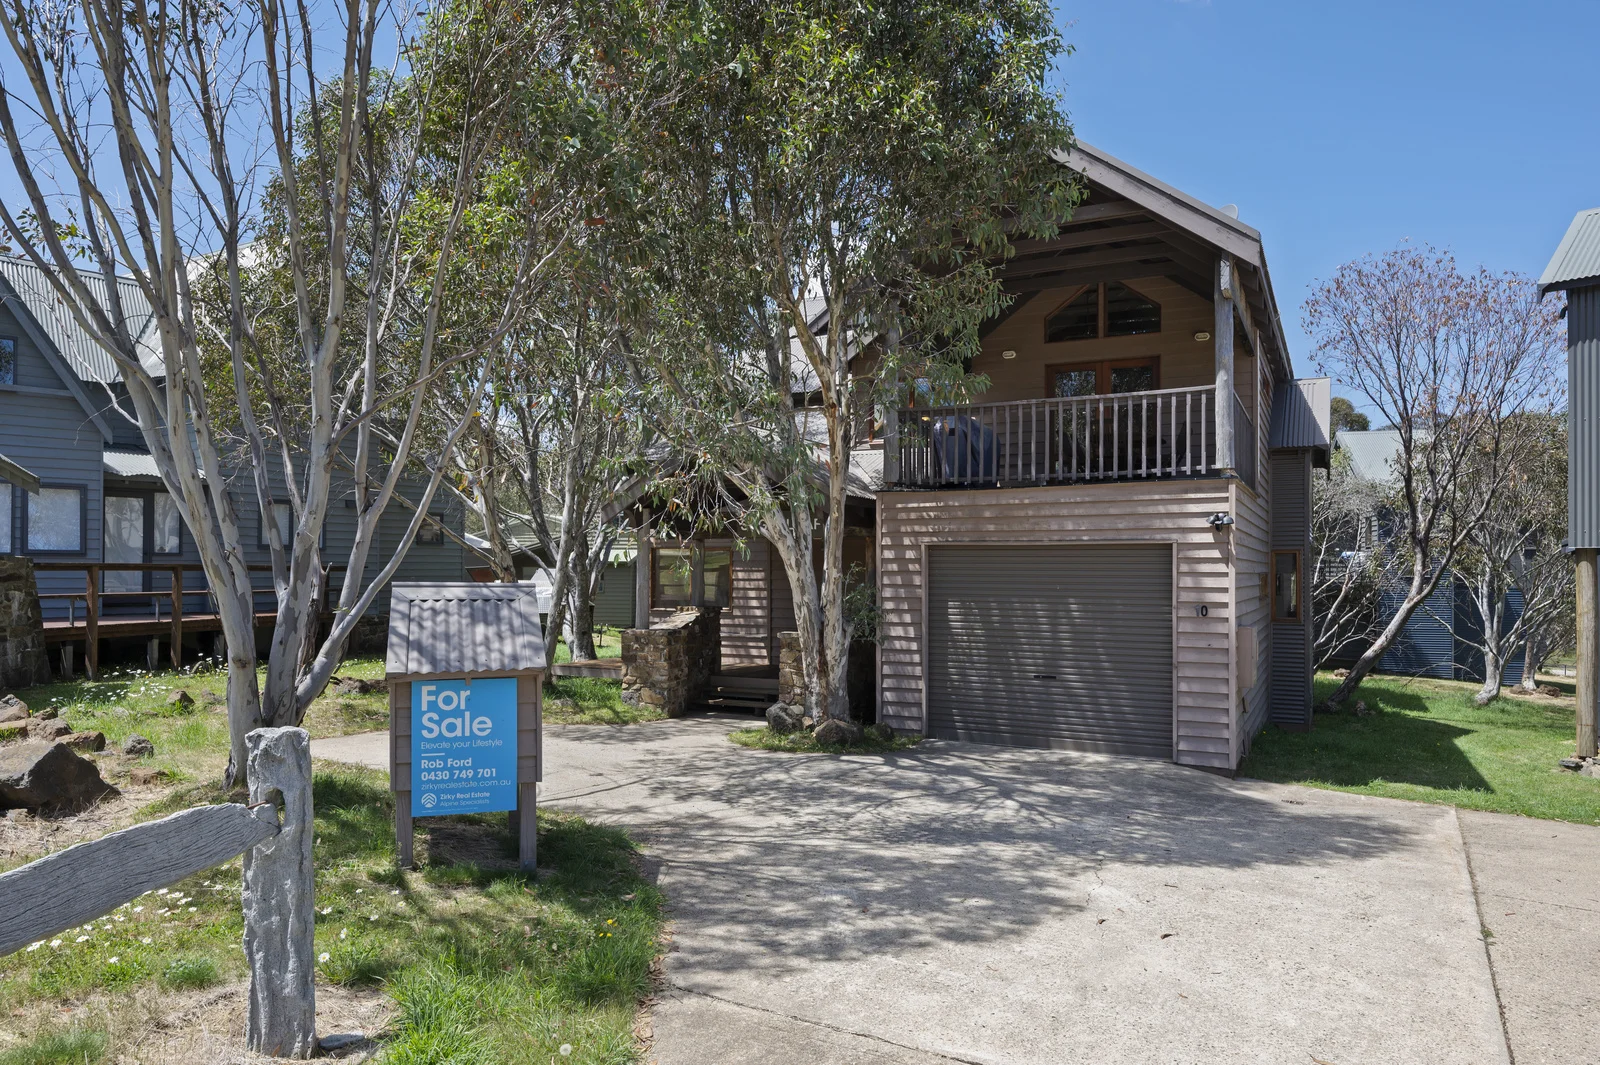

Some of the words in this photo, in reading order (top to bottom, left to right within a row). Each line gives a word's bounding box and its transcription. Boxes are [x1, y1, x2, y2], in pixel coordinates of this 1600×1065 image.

[421, 685, 470, 711] For
[421, 711, 493, 738] Sale
[421, 741, 451, 750] Elevate
[453, 740, 470, 751] your
[472, 739, 502, 748] Lifestyle
[421, 758, 444, 769] Rob
[448, 758, 472, 767] Ford
[421, 770, 450, 780] 0430
[453, 769, 474, 779] 749
[477, 768, 496, 778] 701
[421, 779, 511, 790] zirkyrealestate.com.au
[440, 793, 455, 801] Zirky
[457, 791, 470, 799] Real
[460, 798, 489, 806] Specialists
